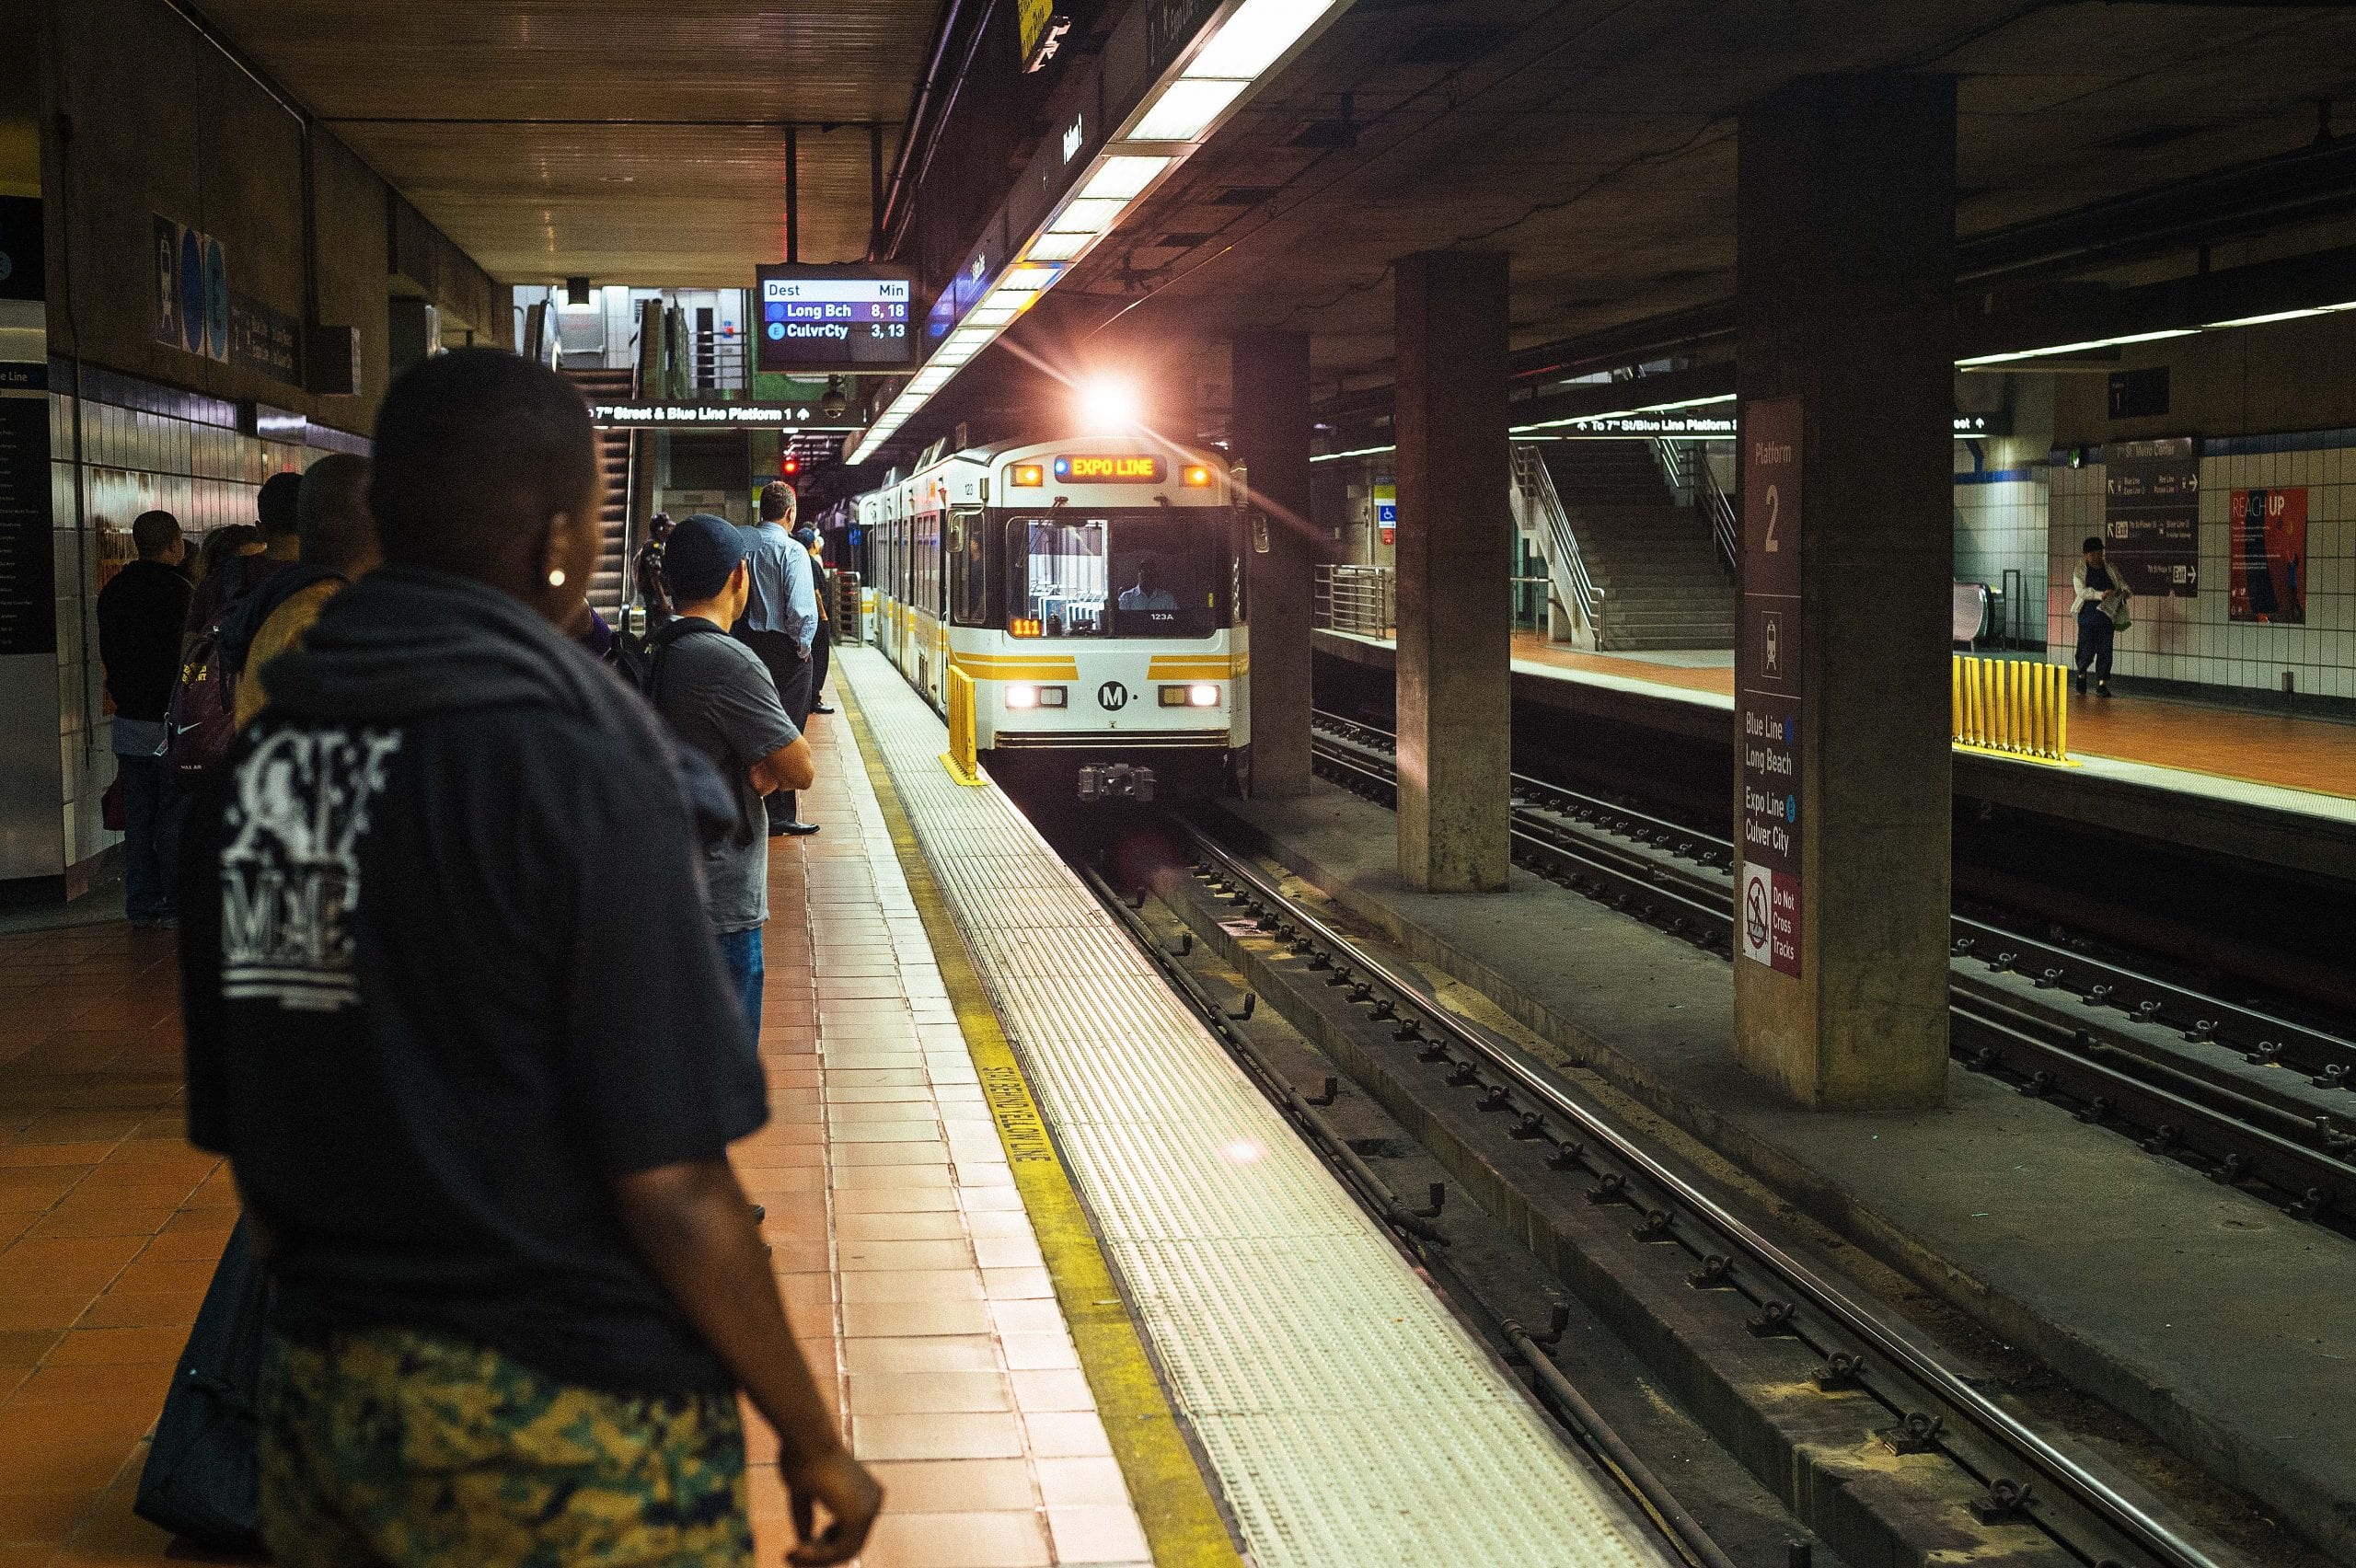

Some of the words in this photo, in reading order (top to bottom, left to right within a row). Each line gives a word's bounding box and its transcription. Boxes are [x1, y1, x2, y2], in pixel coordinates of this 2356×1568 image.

[769, 284, 800, 296] Dest
[879, 284, 904, 296] Min
[787, 304, 822, 319] Long
[825, 304, 852, 317] Bch
[871, 305, 884, 318] 8,
[888, 304, 905, 317] 18
[787, 324, 849, 340] CulvrCty
[871, 324, 884, 339] 3,
[888, 324, 906, 338] 13
[614, 407, 653, 421] Street
[654, 407, 664, 421] &
[667, 407, 697, 421] Blue
[699, 407, 726, 421] Line
[729, 407, 782, 421] Platform
[784, 408, 791, 420] 1
[1591, 420, 1604, 432] To
[1662, 420, 1684, 432] Line
[1686, 420, 1731, 432] Platform
[1755, 442, 1792, 466] Platform
[1072, 459, 1113, 475] EXPO
[1116, 459, 1153, 475] LINE
[964, 484, 973, 495] 123
[2232, 496, 2267, 517] REACH
[2269, 495, 2285, 516] UP
[1765, 484, 1779, 552] 2
[1013, 619, 1041, 635] 111
[1102, 686, 1124, 707] M
[1746, 711, 1763, 735] Blue
[1765, 715, 1783, 740] Line
[1746, 744, 1765, 775] Long
[1766, 747, 1792, 776] Beach
[1746, 786, 1765, 816] Expo
[1766, 792, 1784, 818] Line
[1746, 818, 1771, 847] Culver
[1773, 825, 1790, 857] City
[1773, 886, 1782, 905] Do
[1783, 892, 1795, 911] Not
[1773, 911, 1791, 933] Cross
[1773, 934, 1795, 961] Tracks
